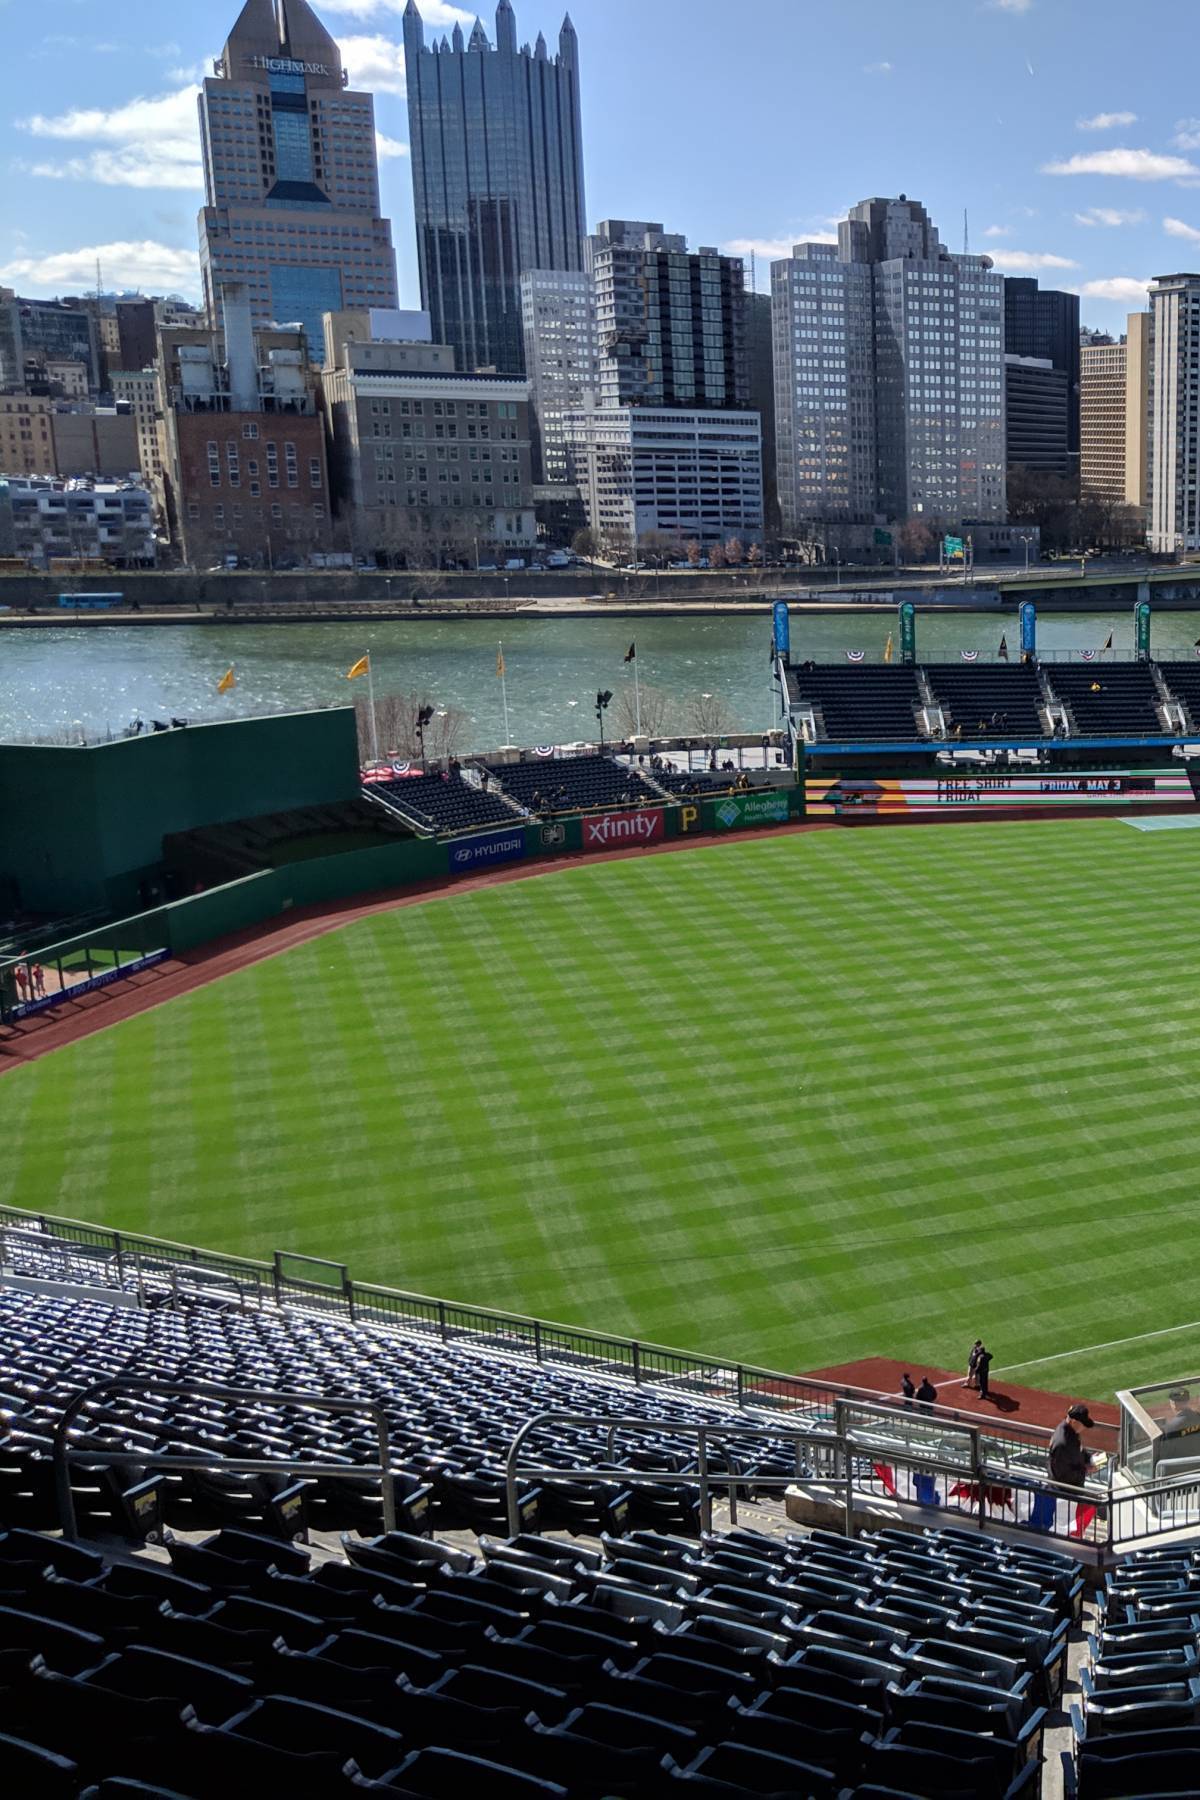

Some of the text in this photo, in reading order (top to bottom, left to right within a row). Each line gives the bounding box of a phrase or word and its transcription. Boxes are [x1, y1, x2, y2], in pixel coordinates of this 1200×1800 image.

[254, 55, 329, 76] HIGHMARK
[937, 779, 1012, 790] FREE SHIRT
[1087, 780, 1110, 790] MAY
[937, 791, 981, 802] FRIDAY
[682, 806, 698, 831] P
[588, 815, 658, 844] xfinity
[475, 840, 521, 857] HYUNDAI
